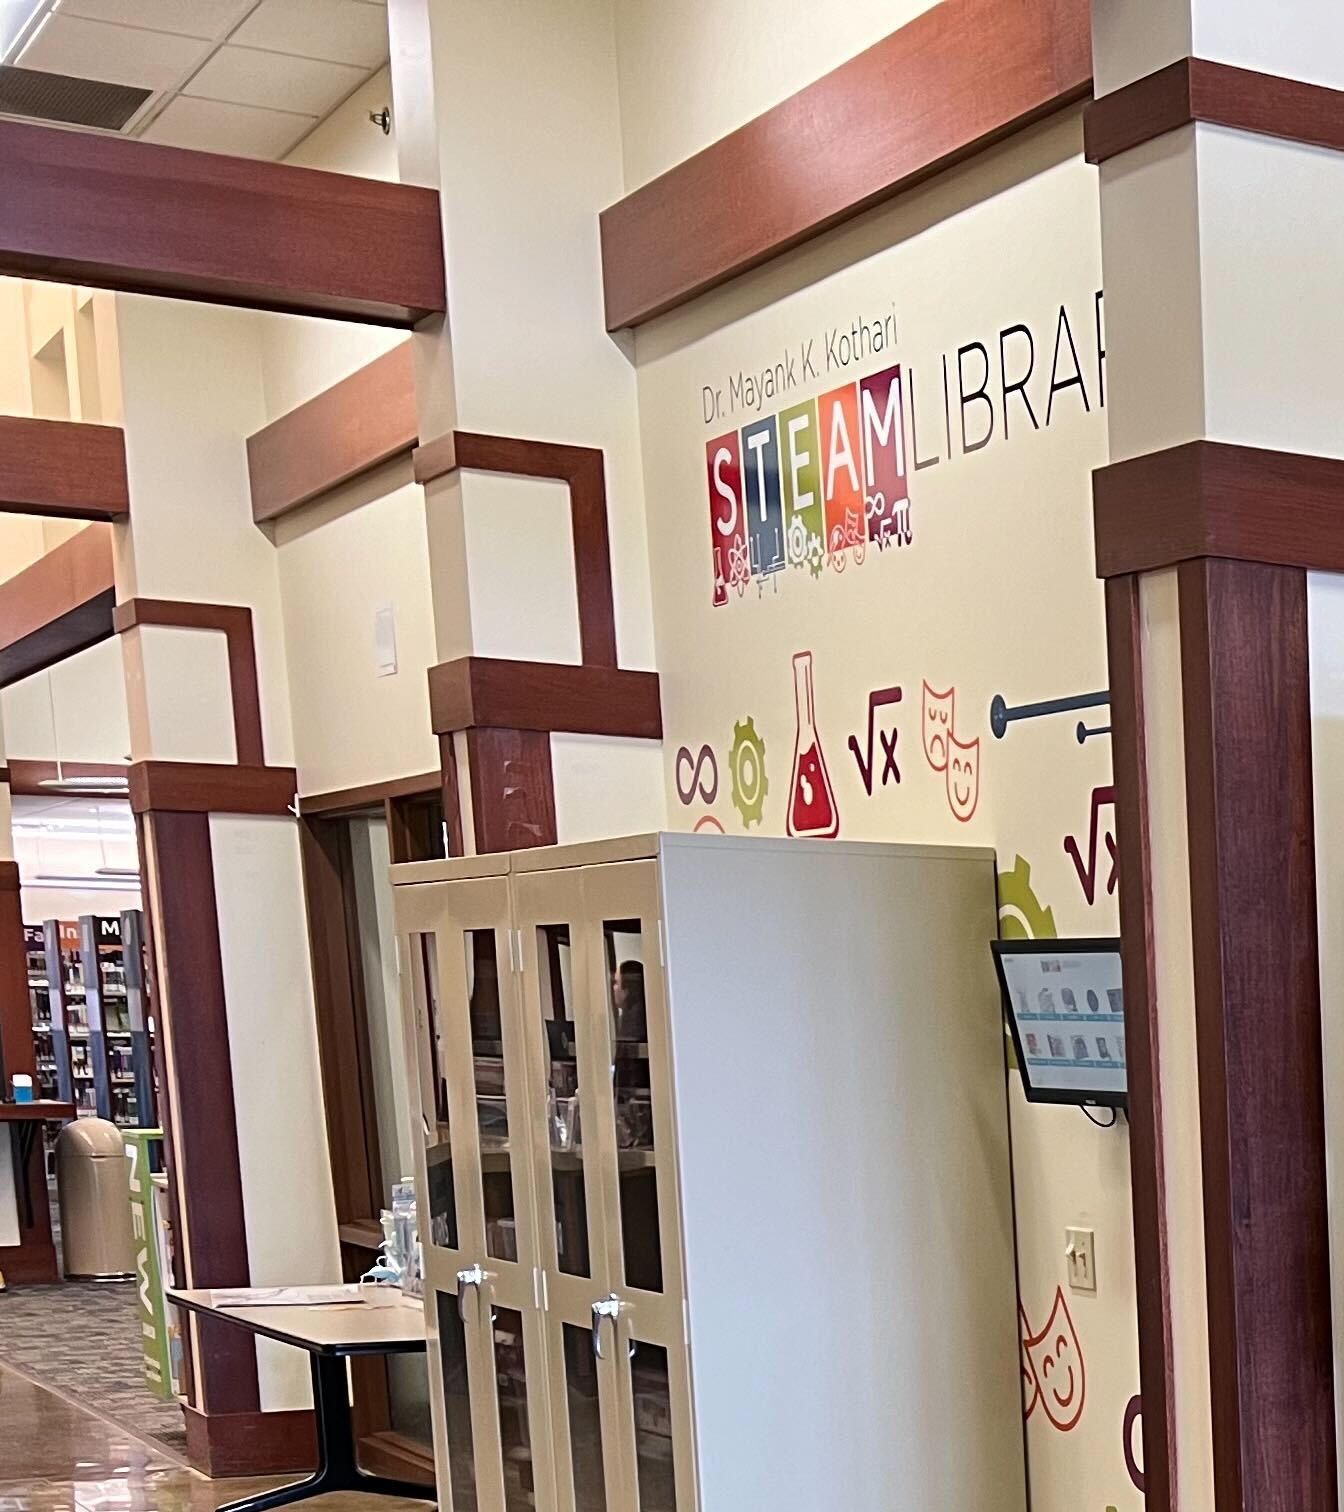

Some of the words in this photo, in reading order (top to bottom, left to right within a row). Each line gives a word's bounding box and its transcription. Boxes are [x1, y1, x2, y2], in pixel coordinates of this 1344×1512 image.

[703, 383, 724, 424] Dr.
[729, 351, 798, 416] Mayank
[800, 339, 820, 384] K.
[825, 302, 898, 373] Kothari
[712, 377, 906, 536] STEAM
